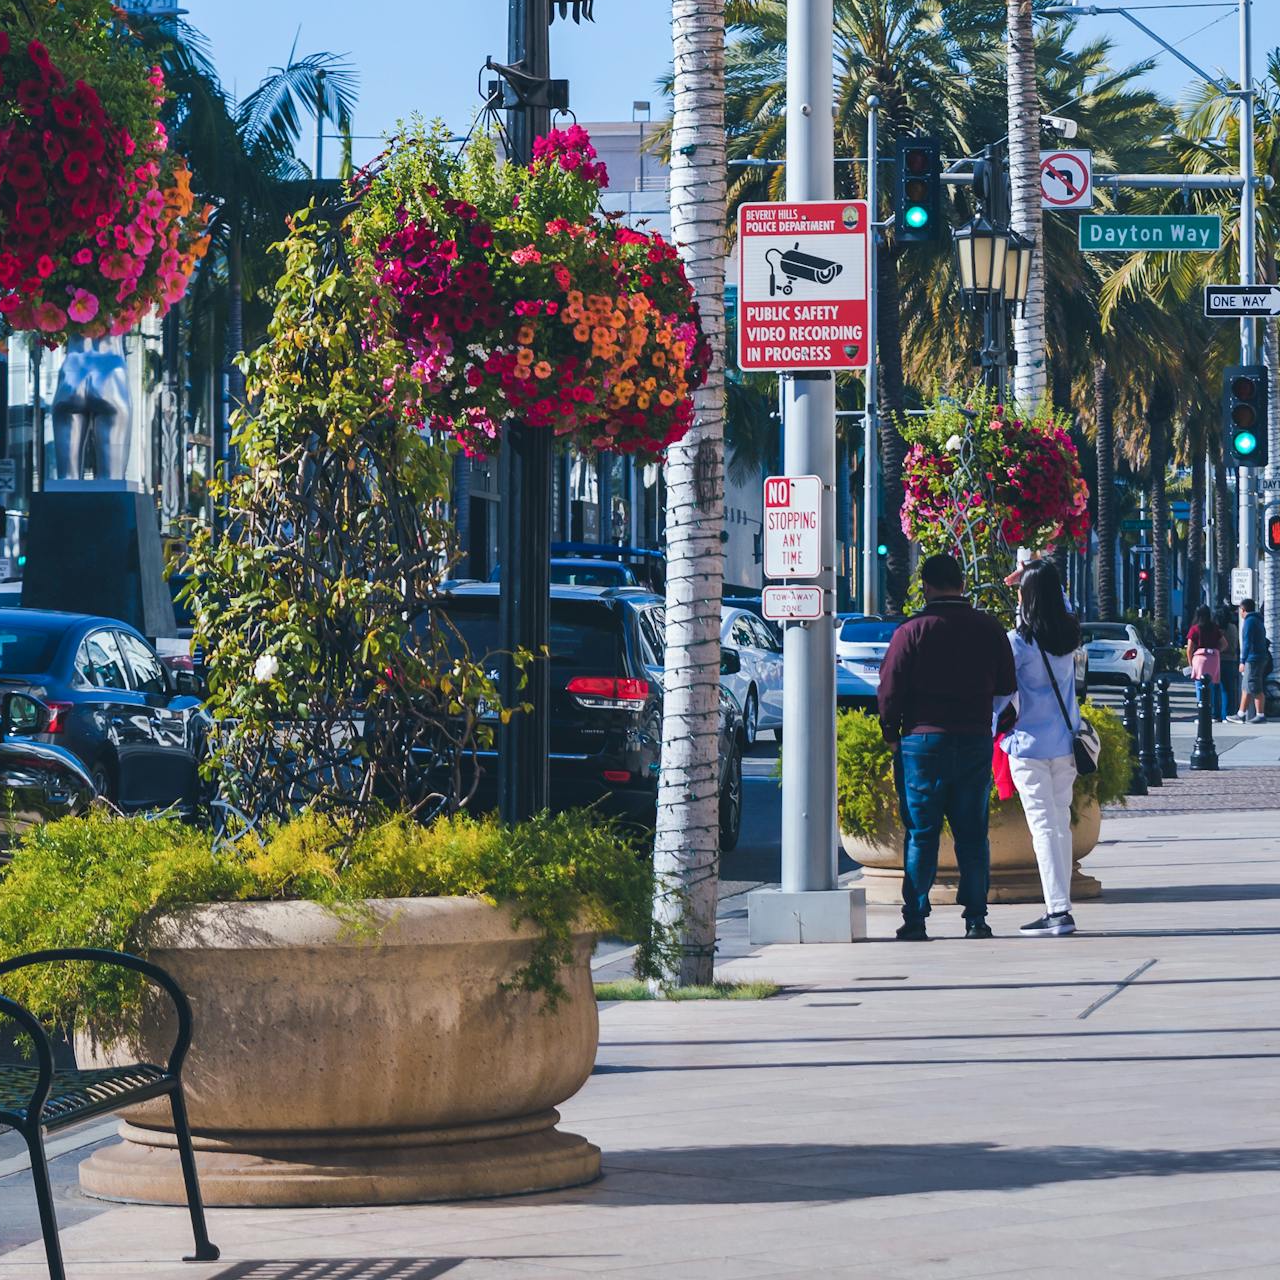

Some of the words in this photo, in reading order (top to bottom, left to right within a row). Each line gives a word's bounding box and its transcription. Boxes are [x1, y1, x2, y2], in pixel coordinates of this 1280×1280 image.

[746, 210, 776, 220] BEVERLY
[778, 209, 798, 220] HILLS
[746, 222, 776, 232] POLICE
[779, 221, 835, 232] DEPARTMENT
[1090, 224, 1163, 245] Dayton
[1170, 224, 1210, 246] Way
[1213, 296, 1236, 307] ONE
[1242, 296, 1266, 307] WAY
[746, 306, 791, 321] PUBLIC
[794, 305, 839, 320] SAFETY
[746, 326, 786, 341] VIDEO
[789, 325, 863, 340] RECORDING
[746, 347, 760, 361] IN
[765, 346, 832, 361] PROGRESS
[768, 482, 787, 504] NO
[769, 512, 816, 530] STOPPING
[783, 534, 801, 547] ANY
[783, 551, 802, 564] TIME
[772, 593, 814, 601] TOW-AWAY
